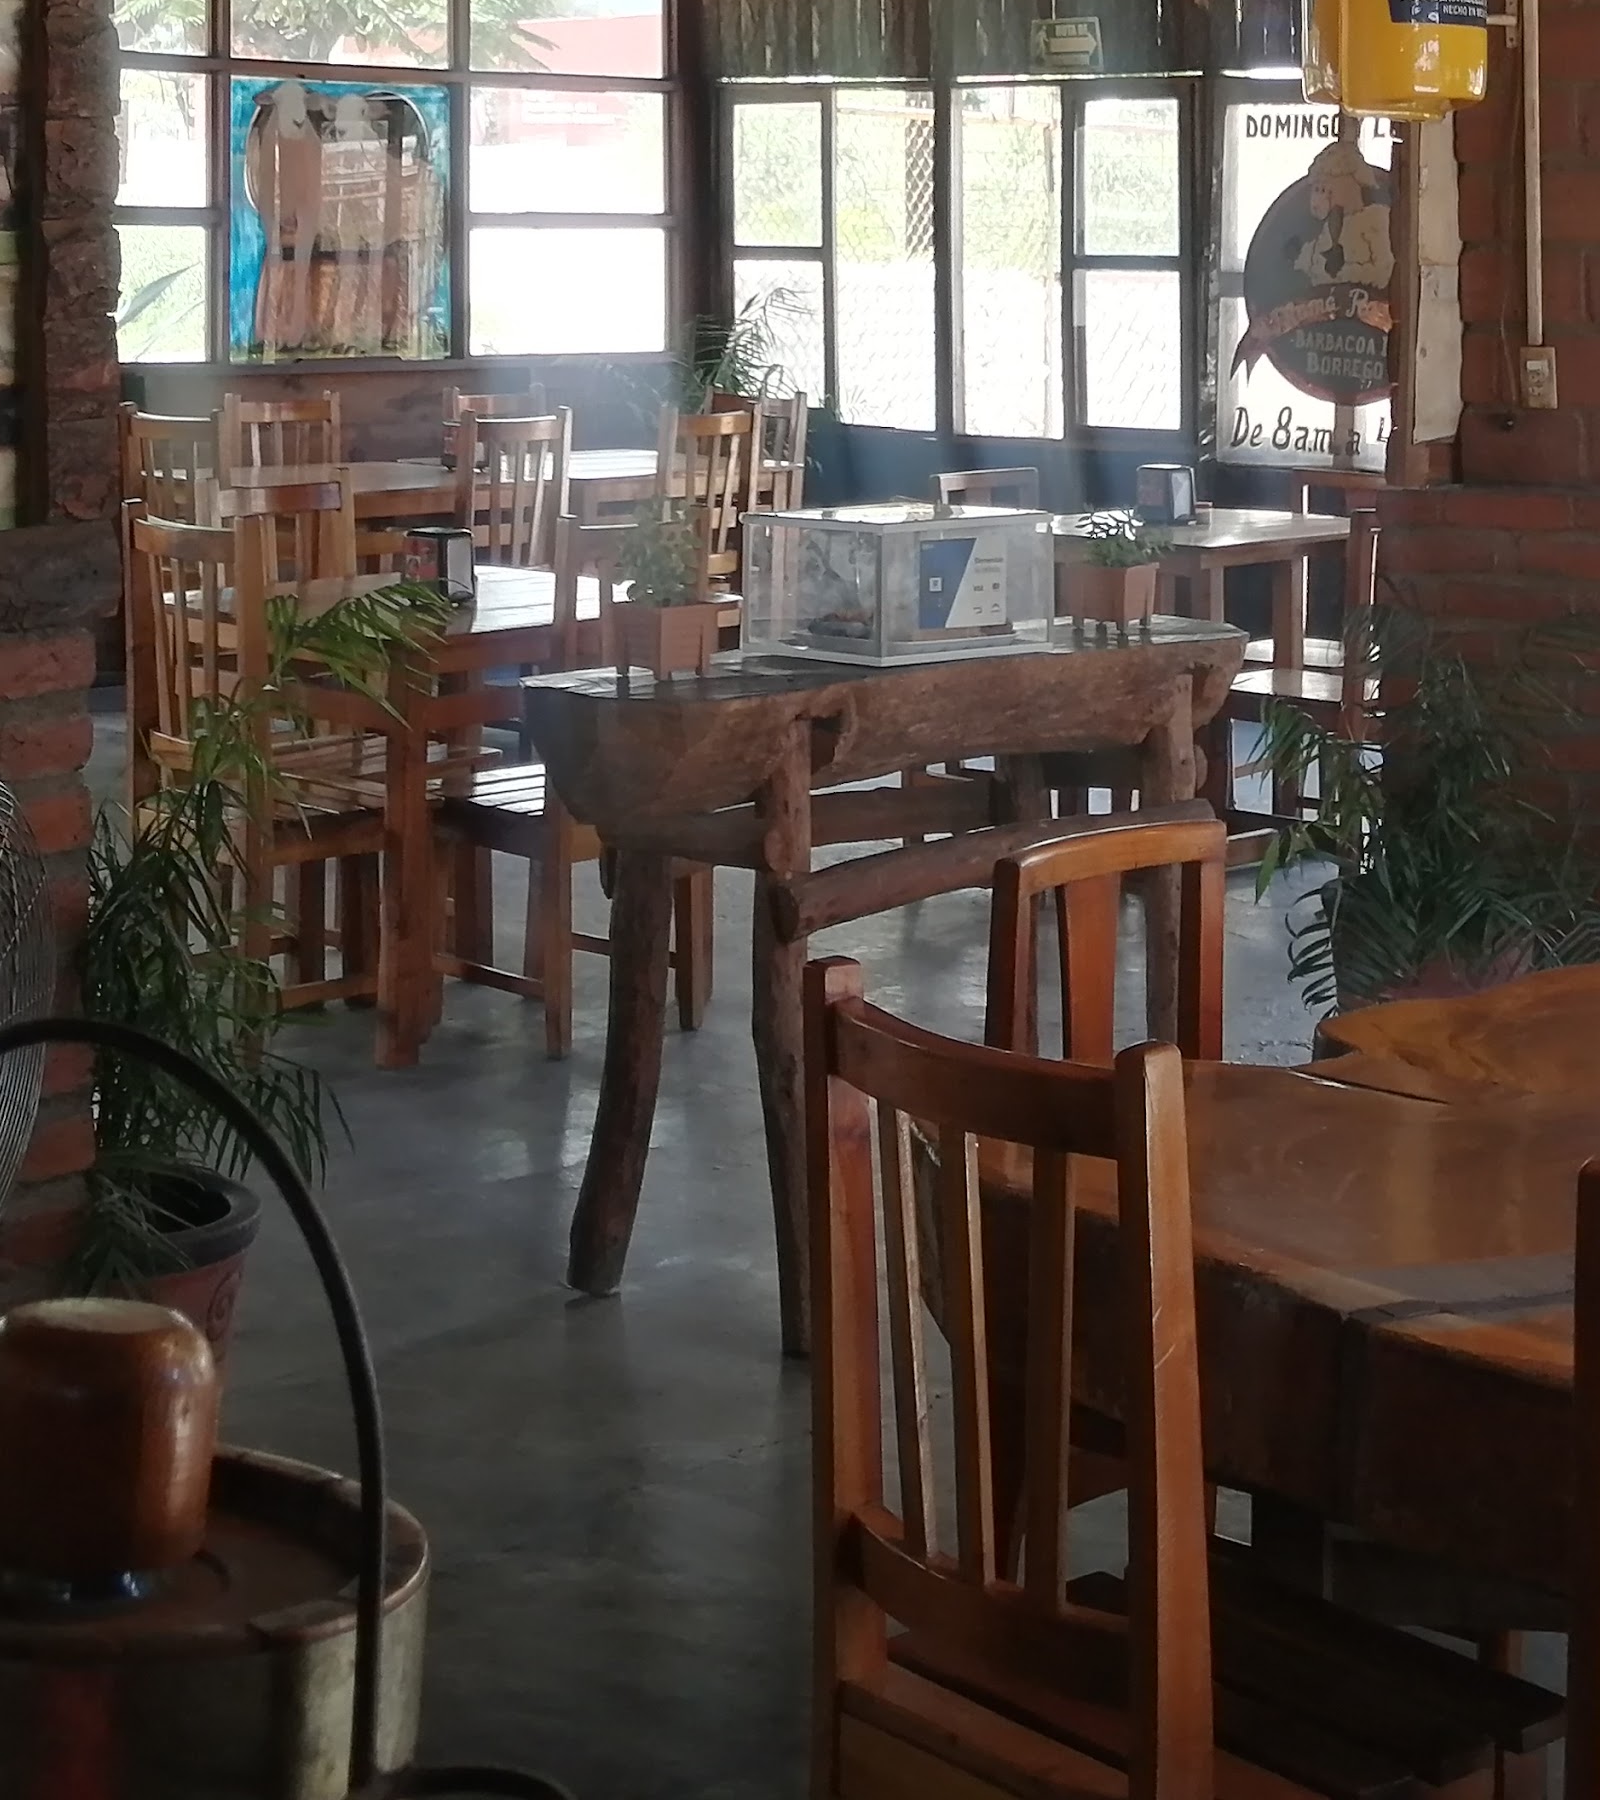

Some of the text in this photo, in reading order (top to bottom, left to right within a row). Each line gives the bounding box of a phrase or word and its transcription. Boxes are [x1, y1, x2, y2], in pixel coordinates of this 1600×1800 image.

[1295, 328, 1376, 357] BARBACOA
[1307, 352, 1384, 381] BORREGO
[1229, 406, 1263, 448] De
